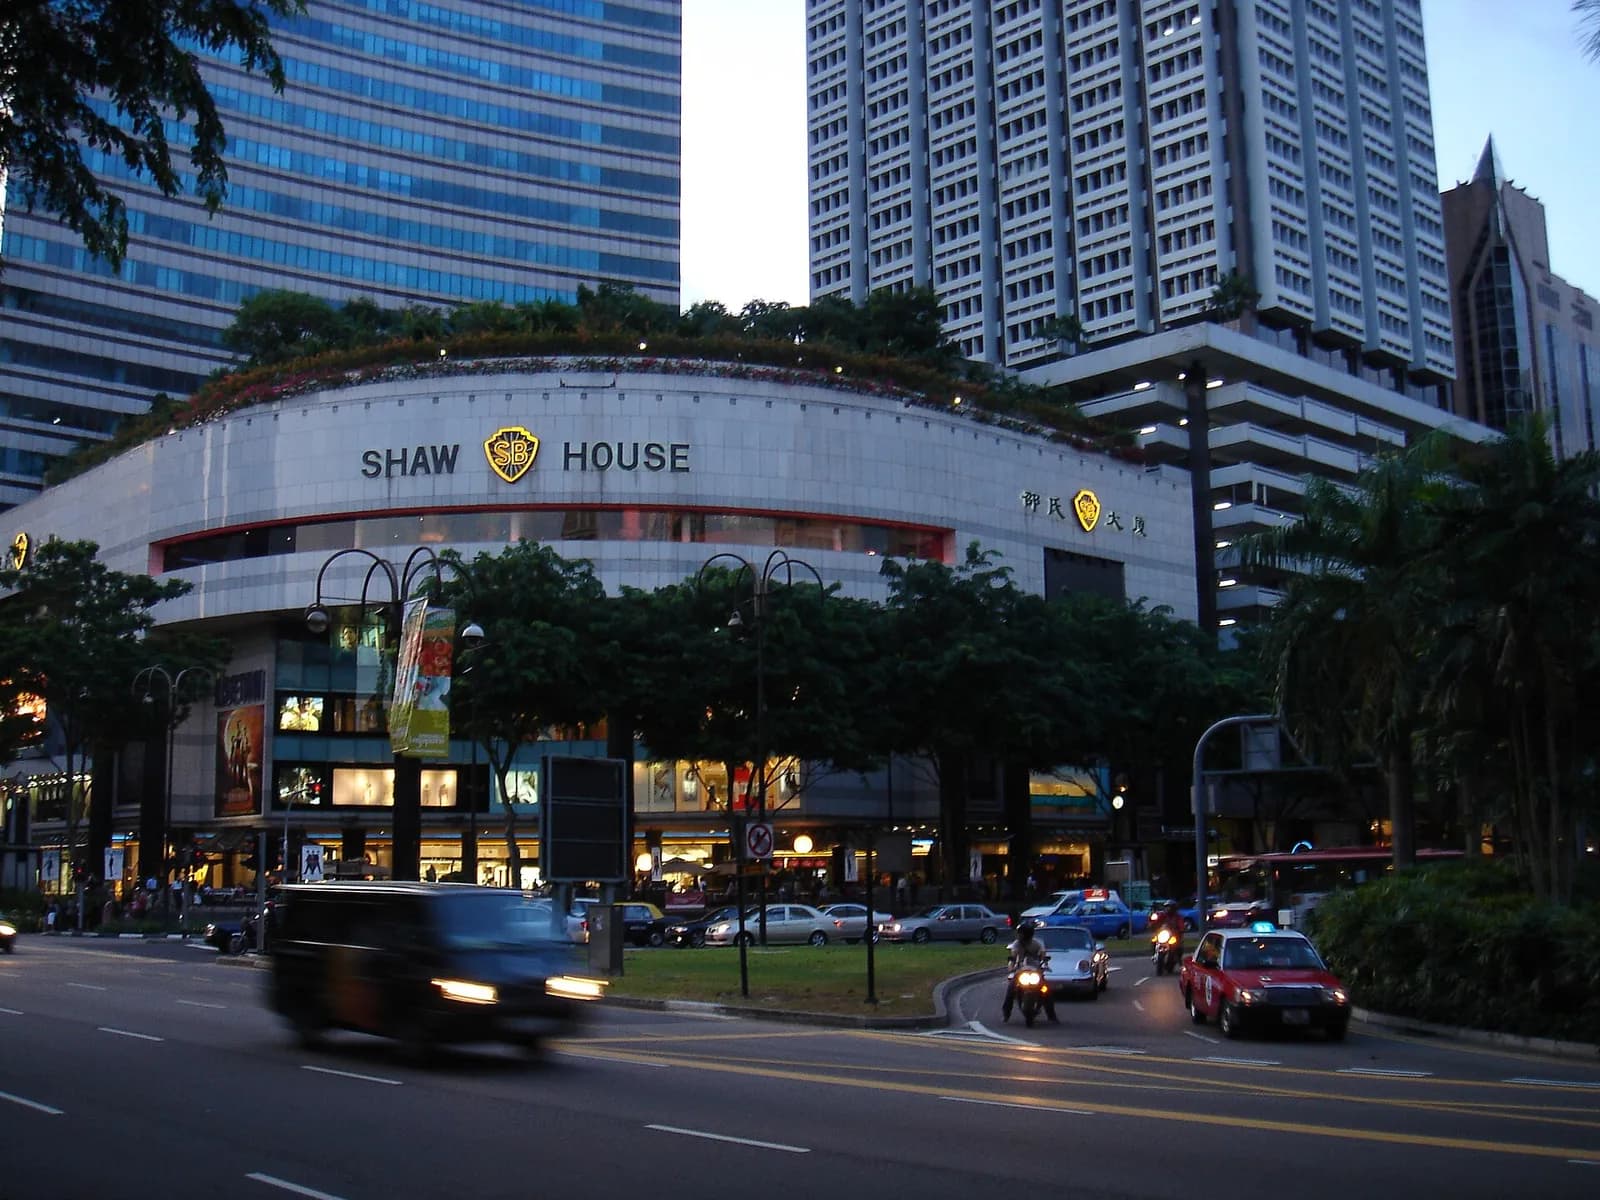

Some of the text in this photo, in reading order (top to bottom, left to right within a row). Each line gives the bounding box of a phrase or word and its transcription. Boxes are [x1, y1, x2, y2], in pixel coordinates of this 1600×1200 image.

[361, 439, 691, 479] SHAW SB HOUSE
